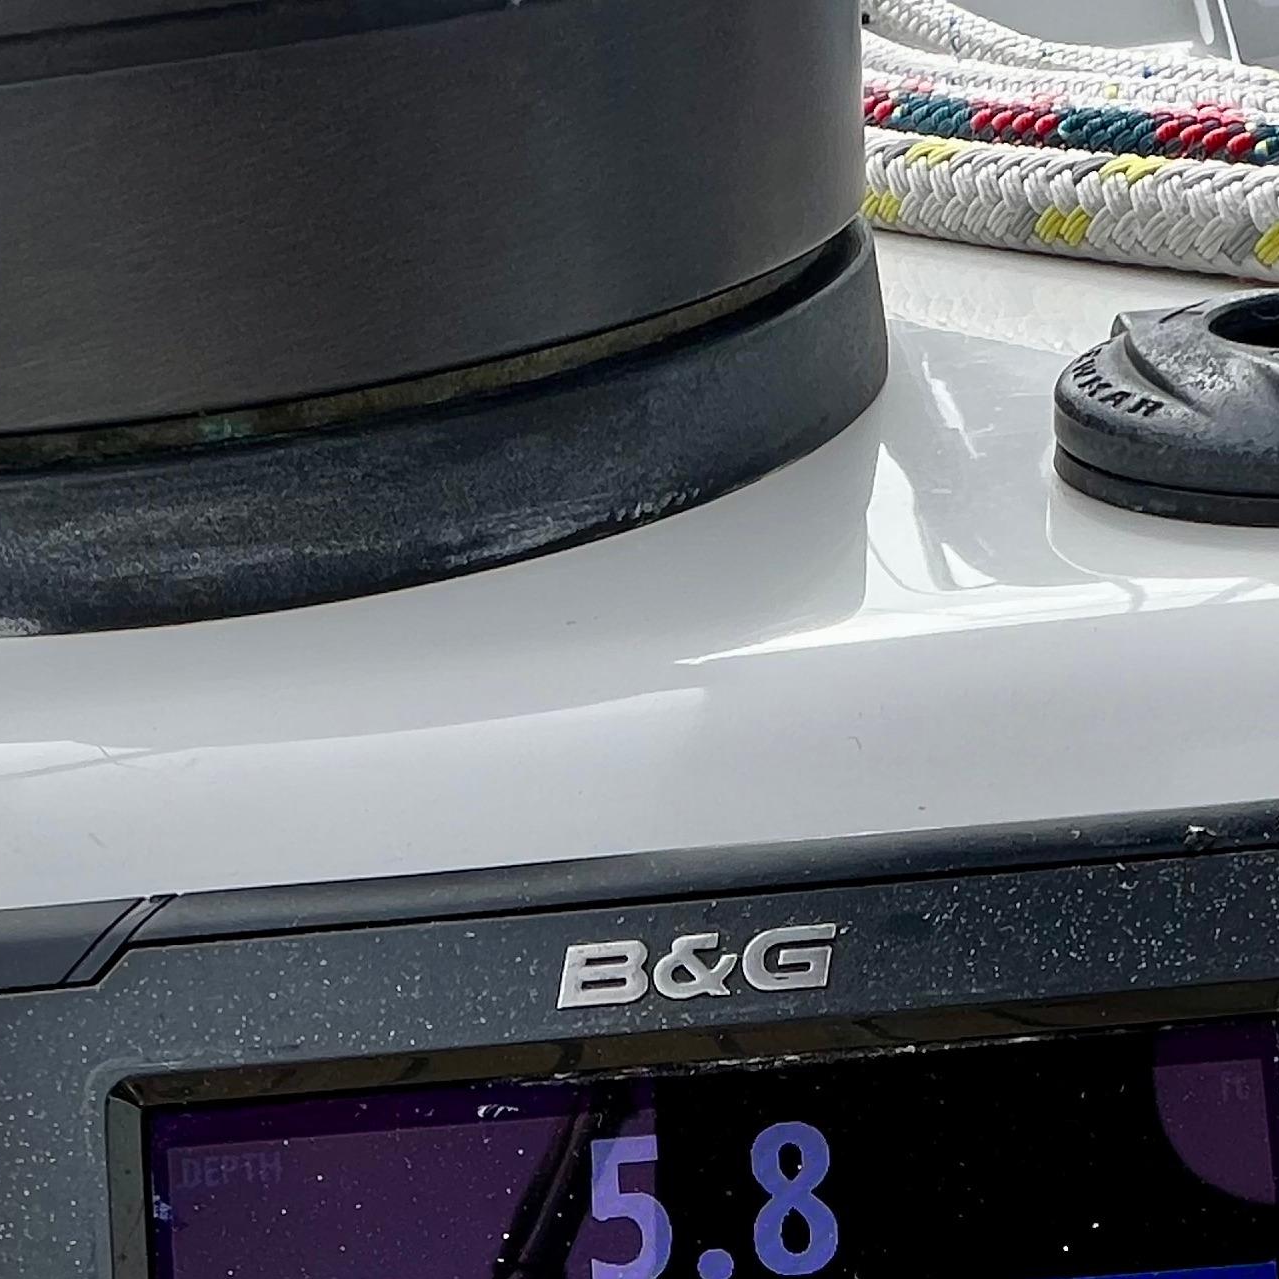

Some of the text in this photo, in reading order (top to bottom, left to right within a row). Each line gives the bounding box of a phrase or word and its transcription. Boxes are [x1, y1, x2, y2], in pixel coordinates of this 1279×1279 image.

[1072, 347, 1165, 416] EWMAR
[557, 923, 837, 1009] B&G
[181, 1150, 282, 1188] DEPTH
